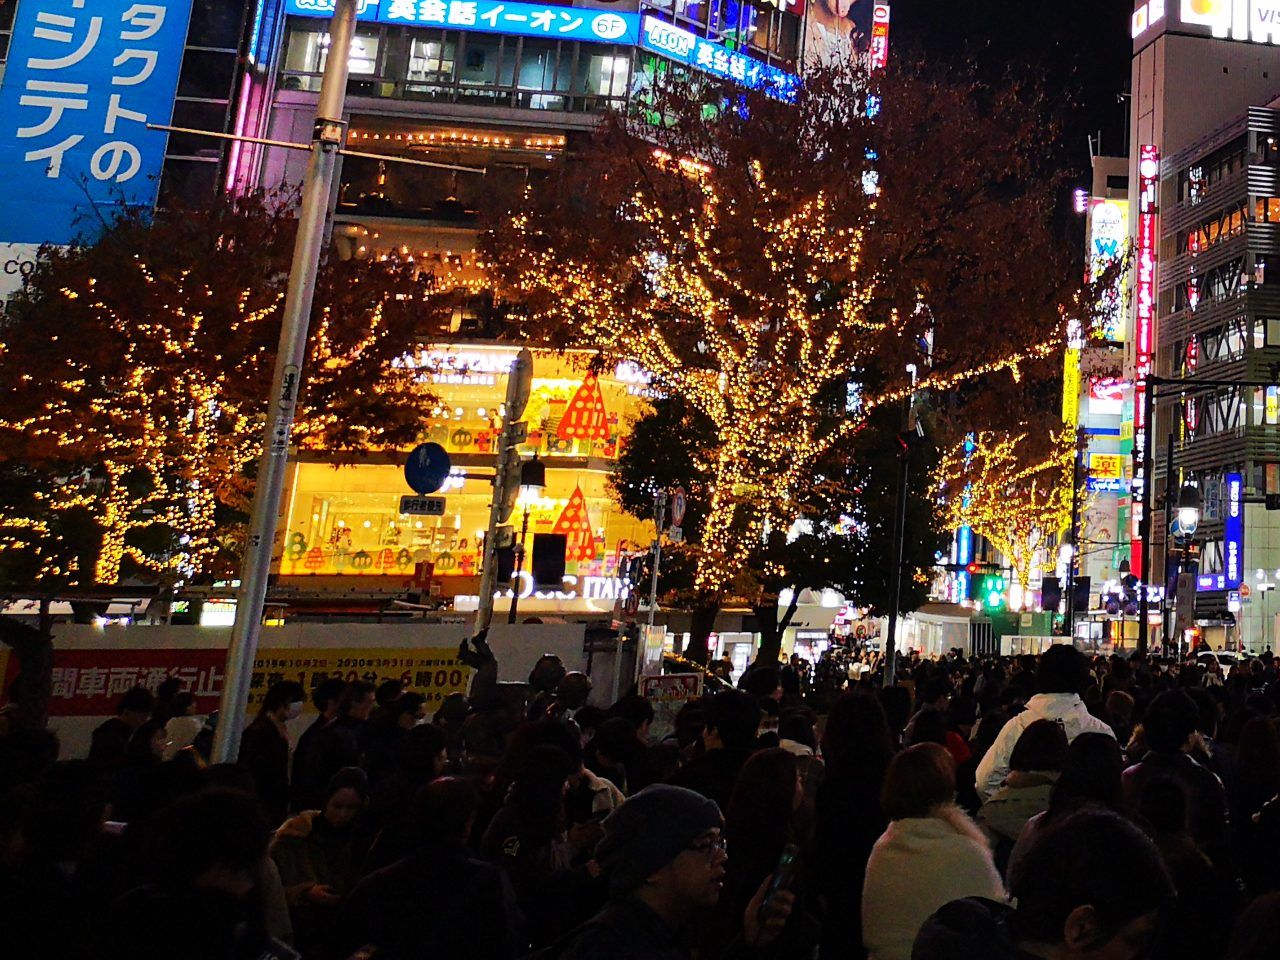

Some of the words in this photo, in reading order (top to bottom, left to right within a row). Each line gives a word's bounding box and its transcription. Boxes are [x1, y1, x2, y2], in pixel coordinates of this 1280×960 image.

[596, 16, 622, 34] 6F
[649, 25, 689, 53] AEON
[1095, 454, 1118, 477] 薬
